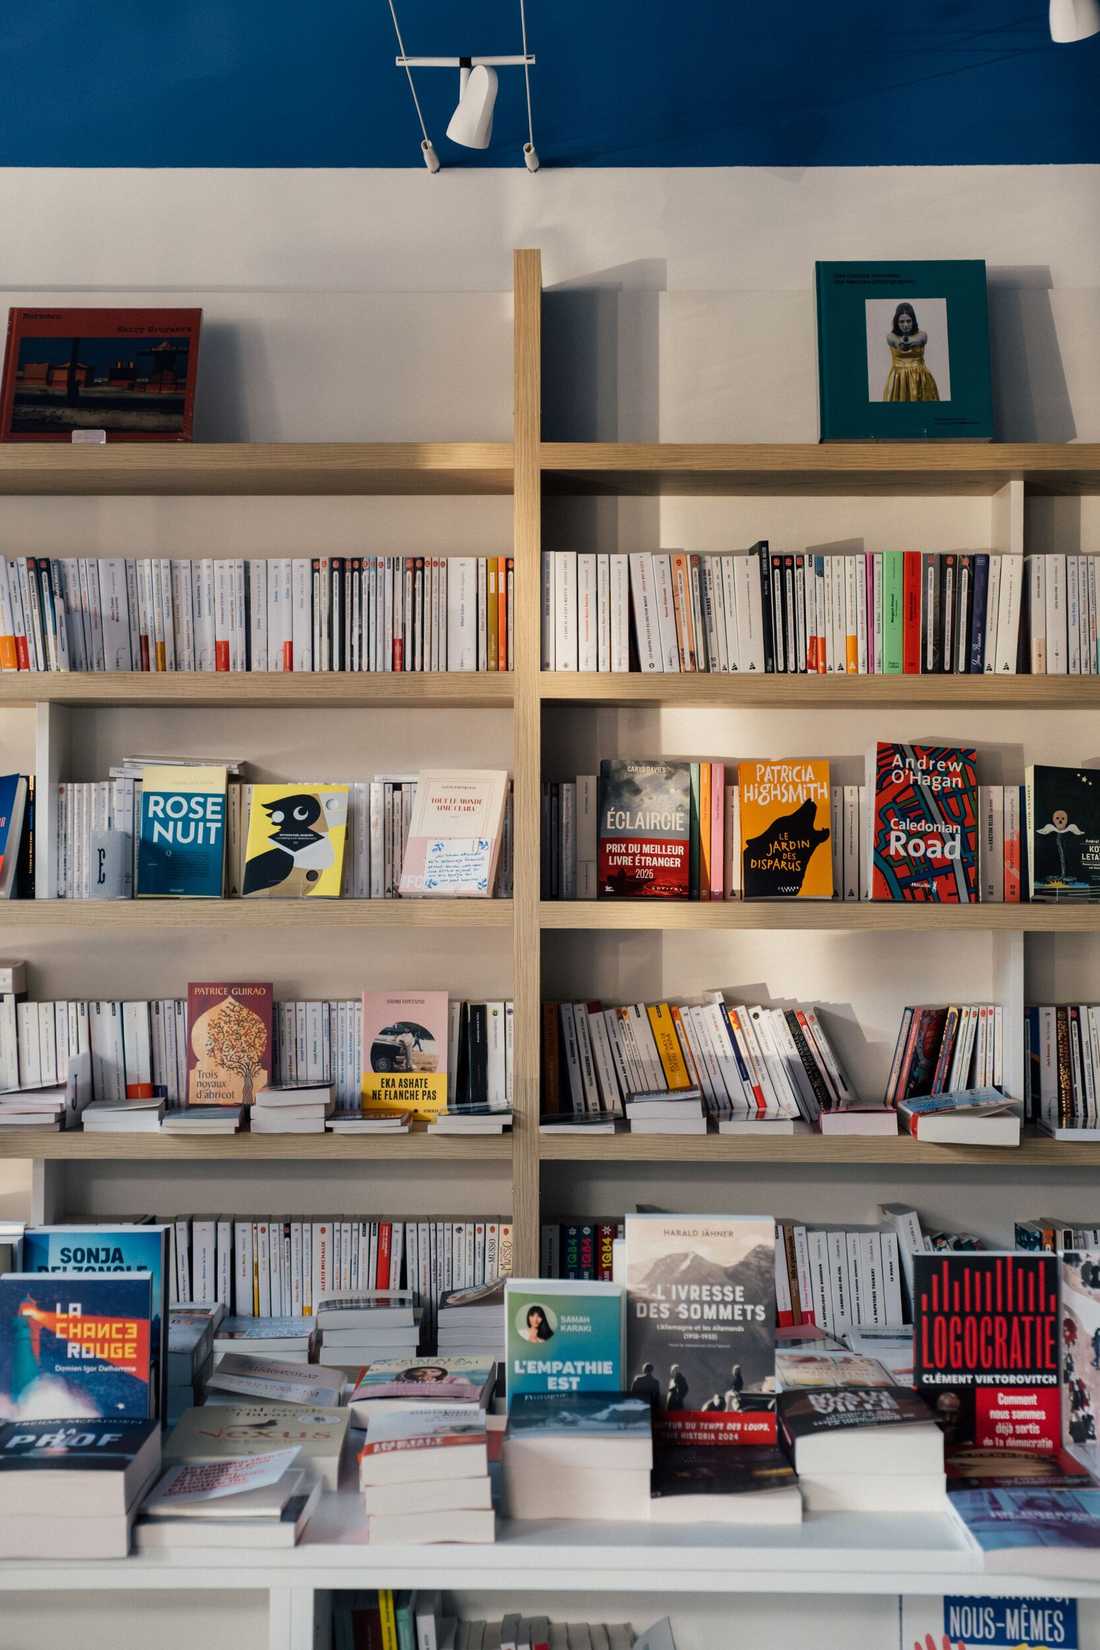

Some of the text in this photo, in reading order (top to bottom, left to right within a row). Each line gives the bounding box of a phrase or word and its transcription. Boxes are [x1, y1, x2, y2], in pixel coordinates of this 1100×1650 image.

[892, 754, 963, 772] Andrew
[892, 769, 961, 791] O'Hagan
[147, 795, 222, 819] ROSE
[606, 807, 685, 831] ÉCLAIRCIE
[152, 821, 222, 844] NUIT
[890, 818, 961, 834] Caledonian
[778, 832, 789, 841] LE
[606, 843, 684, 855] PRIX DU MEILLEUR
[766, 840, 810, 856] JARDIN
[889, 830, 961, 860] Road
[1089, 845, 1100, 853] KO
[608, 855, 681, 868] LIVRE ÉTRANGER
[782, 852, 797, 860] DES
[1081, 853, 1100, 861] LETA
[750, 859, 801, 872] DISPARUS
[194, 987, 267, 996] PATRICE GUIRAO
[197, 1070, 218, 1079] Trois
[196, 1080, 226, 1089] noyaux
[380, 1078, 429, 1089] EKA ASHATE
[371, 1089, 437, 1100] NE FLANCHE PAS
[664, 1229, 699, 1237] HARALD
[60, 1247, 124, 1264] SONJA
[657, 1284, 745, 1301] L'IVRESSE
[55, 1303, 82, 1319] LA
[636, 1303, 766, 1321] DES SOMMETS
[560, 1315, 590, 1323] SAMAH
[921, 1315, 1056, 1369] LOGOCRATIE
[67, 1343, 137, 1359] ROUGE
[55, 1364, 82, 1373] Damien
[83, 1364, 97, 1375] Igor
[514, 1360, 613, 1375] L'EMPATHIE
[547, 1377, 581, 1391] EST
[922, 1372, 1058, 1385] CLÉMENT VIKTOROVITCH
[997, 1392, 1038, 1406] Comment
[989, 1409, 1046, 1420] nous sommes
[685, 1422, 696, 1430] DU
[726, 1423, 741, 1431] DES
[1015, 1423, 1041, 1435] sortis
[680, 1433, 716, 1441] HISTORIA
[718, 1433, 740, 1441] 2024
[983, 1438, 994, 1448] de
[1006, 1437, 1053, 1449] démocratie
[950, 1603, 1065, 1643] NOUS-MÊMES
